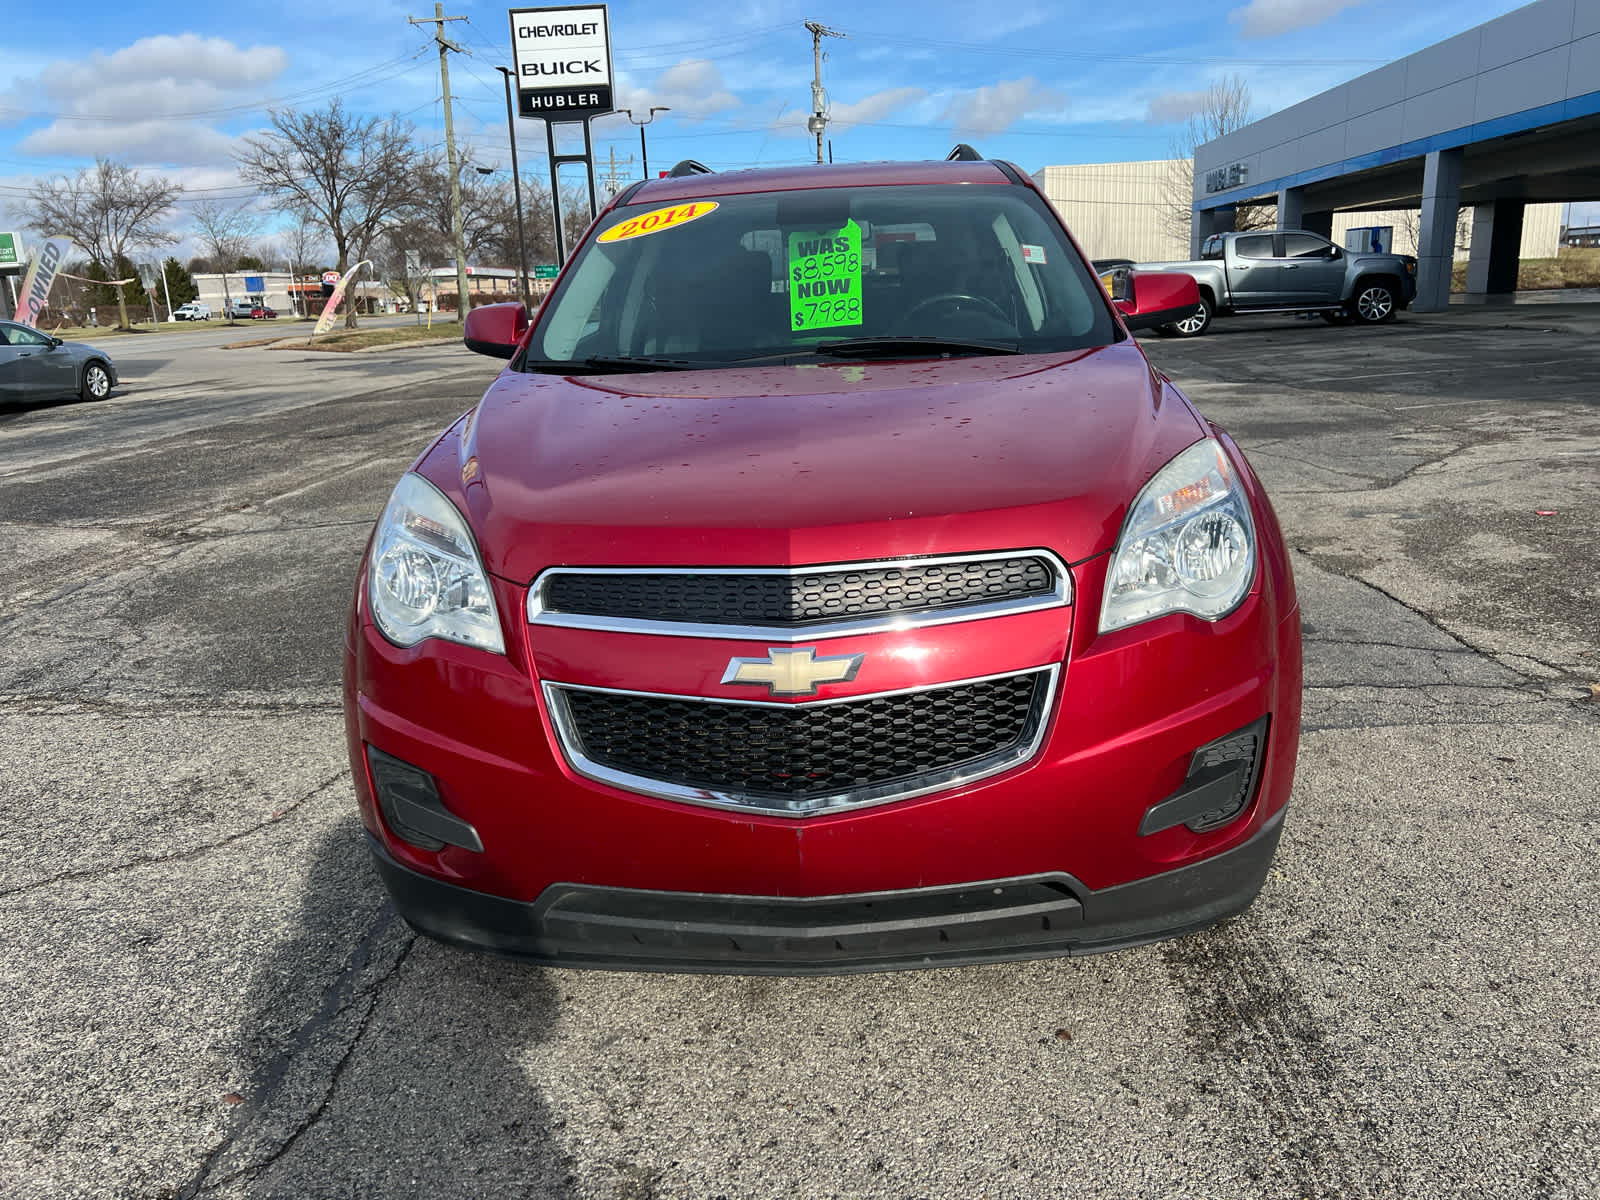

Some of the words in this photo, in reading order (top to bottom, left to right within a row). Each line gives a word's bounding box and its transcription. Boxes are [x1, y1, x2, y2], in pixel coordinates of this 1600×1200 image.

[519, 22, 599, 39] CHEVROLET
[521, 59, 603, 77] BUICK
[531, 93, 600, 108] HUBLER
[617, 204, 698, 239] 2014
[797, 236, 851, 258] WAS
[792, 252, 860, 282] $8,598
[797, 278, 852, 299] NOW
